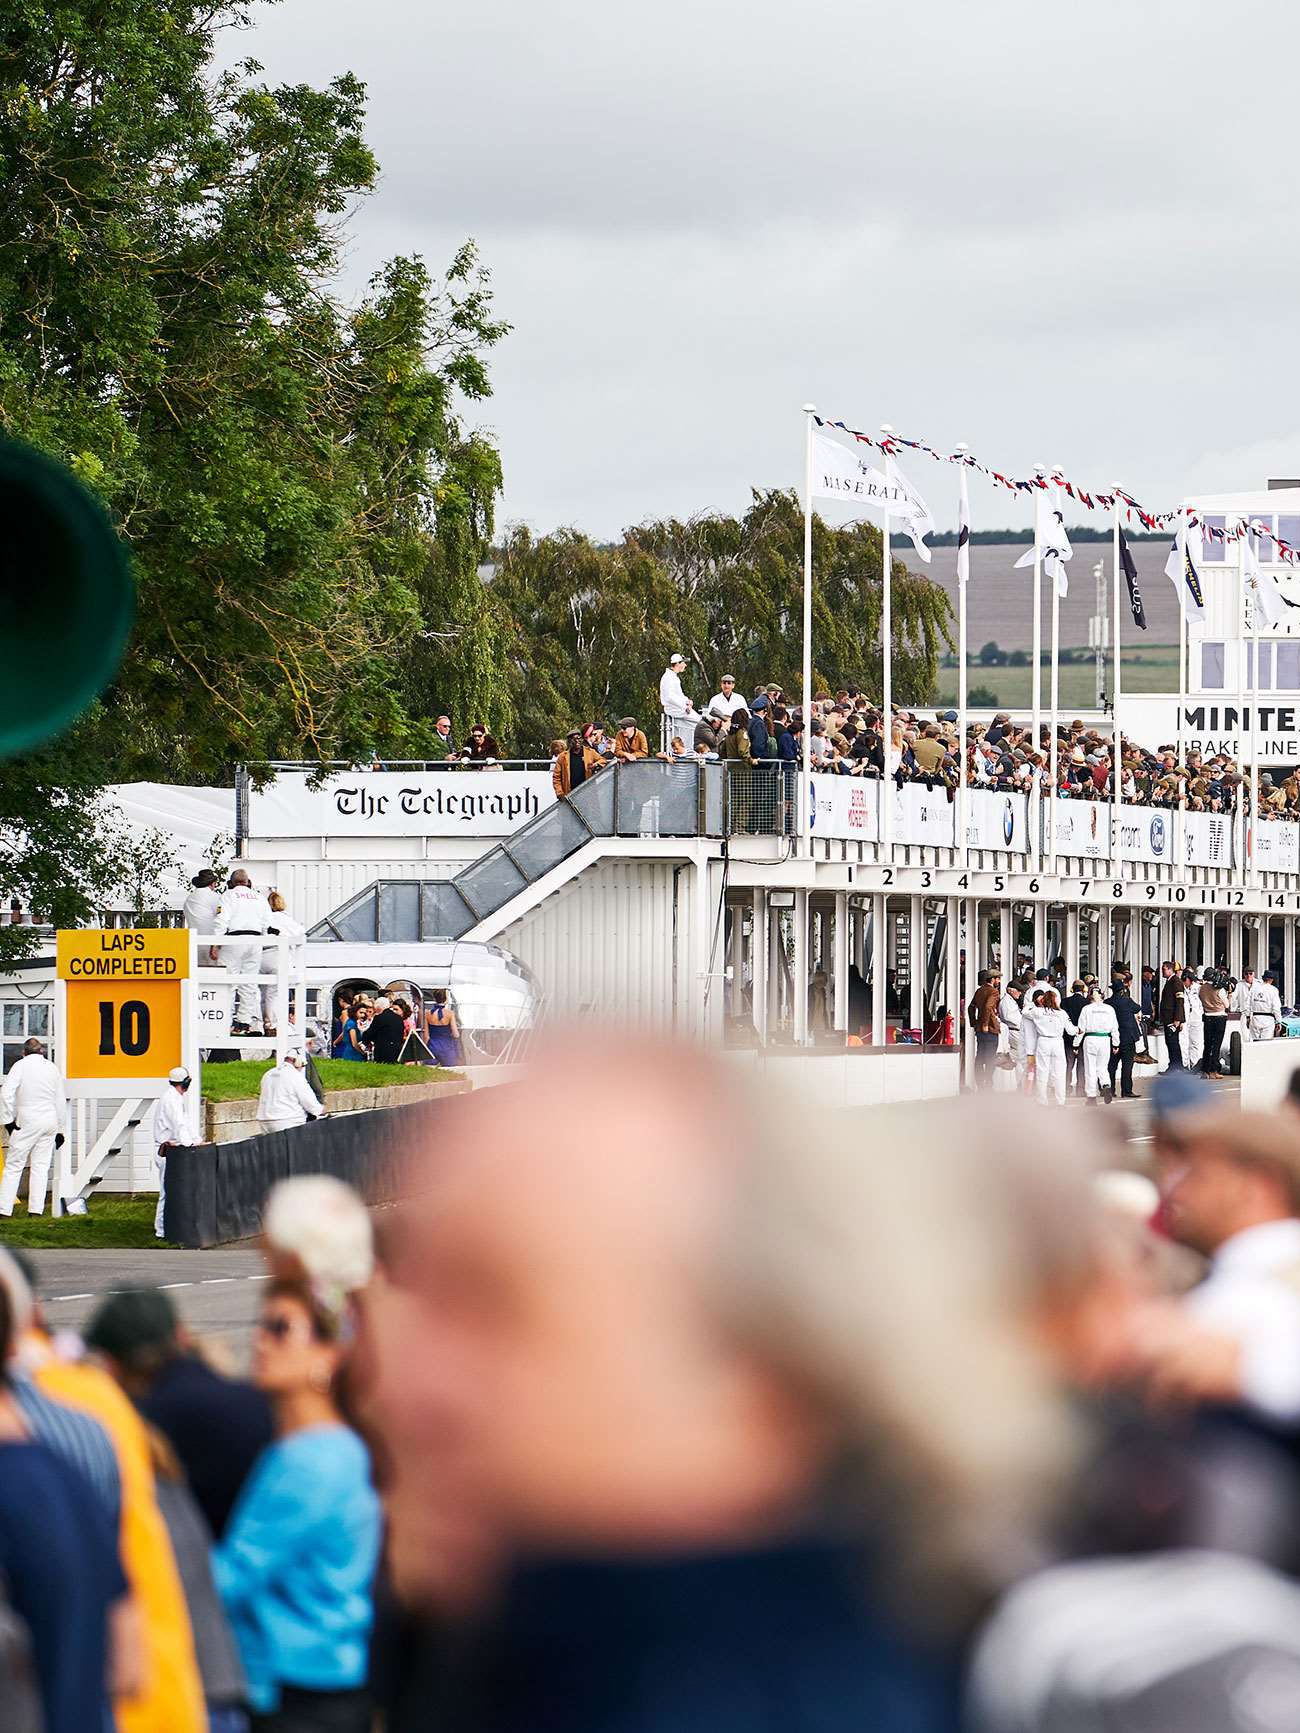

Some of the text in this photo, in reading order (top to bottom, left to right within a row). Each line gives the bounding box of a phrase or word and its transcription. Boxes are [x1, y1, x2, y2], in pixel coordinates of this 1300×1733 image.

[823, 476, 909, 501] MASERATI
[334, 788, 538, 820] The Telegraph
[849, 867, 852, 882] 1
[883, 869, 893, 885] 2
[921, 872, 931, 887] 3
[958, 874, 968, 889] 4
[994, 877, 1004, 891] 5
[1029, 879, 1039, 893] 6
[1080, 882, 1090, 896] 7
[1113, 883, 1123, 898] 8
[1146, 886, 1156, 899] 9
[1168, 888, 1185, 901] 10
[1201, 890, 1215, 903] 11
[1227, 892, 1244, 905] 12
[1268, 895, 1284, 908] 14
[101, 933, 145, 951] LAPS
[70, 957, 176, 975] COMPLETED
[199, 1010, 224, 1020] YED
[99, 1000, 150, 1056] 10
